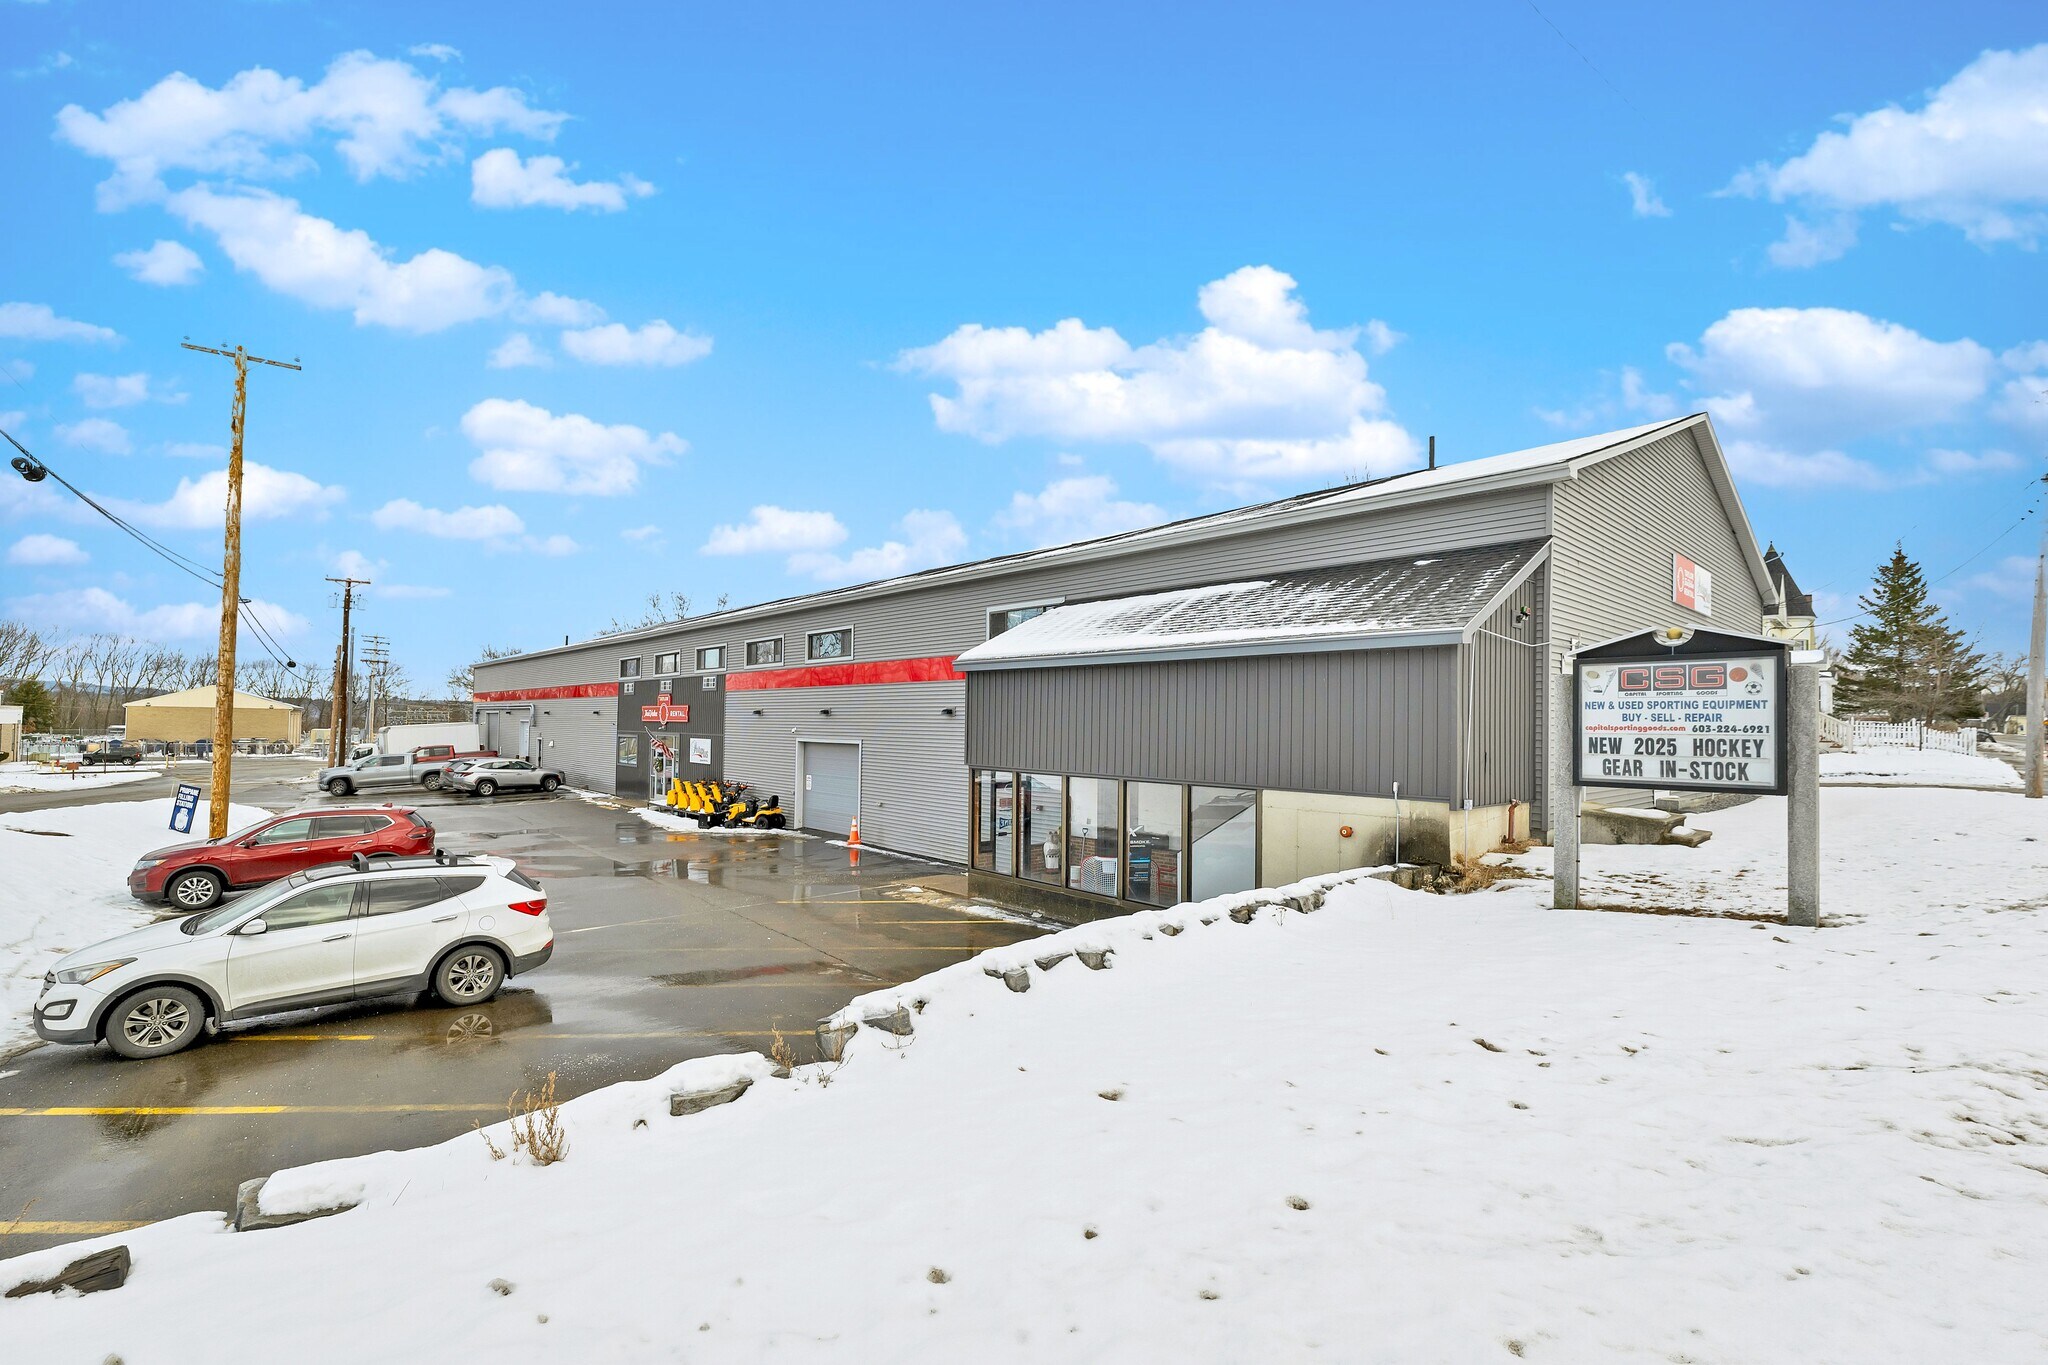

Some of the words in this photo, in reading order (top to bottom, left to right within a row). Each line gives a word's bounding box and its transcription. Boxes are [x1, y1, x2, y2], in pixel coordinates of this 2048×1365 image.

[1585, 701, 1606, 710] NEW
[1608, 701, 1615, 710] &
[1618, 701, 1644, 710] USED
[1647, 700, 1699, 710] SPORTING
[1702, 700, 1768, 710] EQUIPMENT
[1621, 713, 1642, 722] BUY
[1650, 713, 1675, 722] SELL
[1684, 713, 1723, 722] REPAIR
[1585, 724, 1686, 733] capitalsportinggoods.com
[1691, 724, 1770, 733] 603-224-6921
[1588, 737, 1622, 754] NEW
[1634, 737, 1677, 756] 2025
[1692, 738, 1764, 758] HOCKEY
[1602, 758, 1643, 777] GEAR
[179, 786, 200, 796] PROPANE
